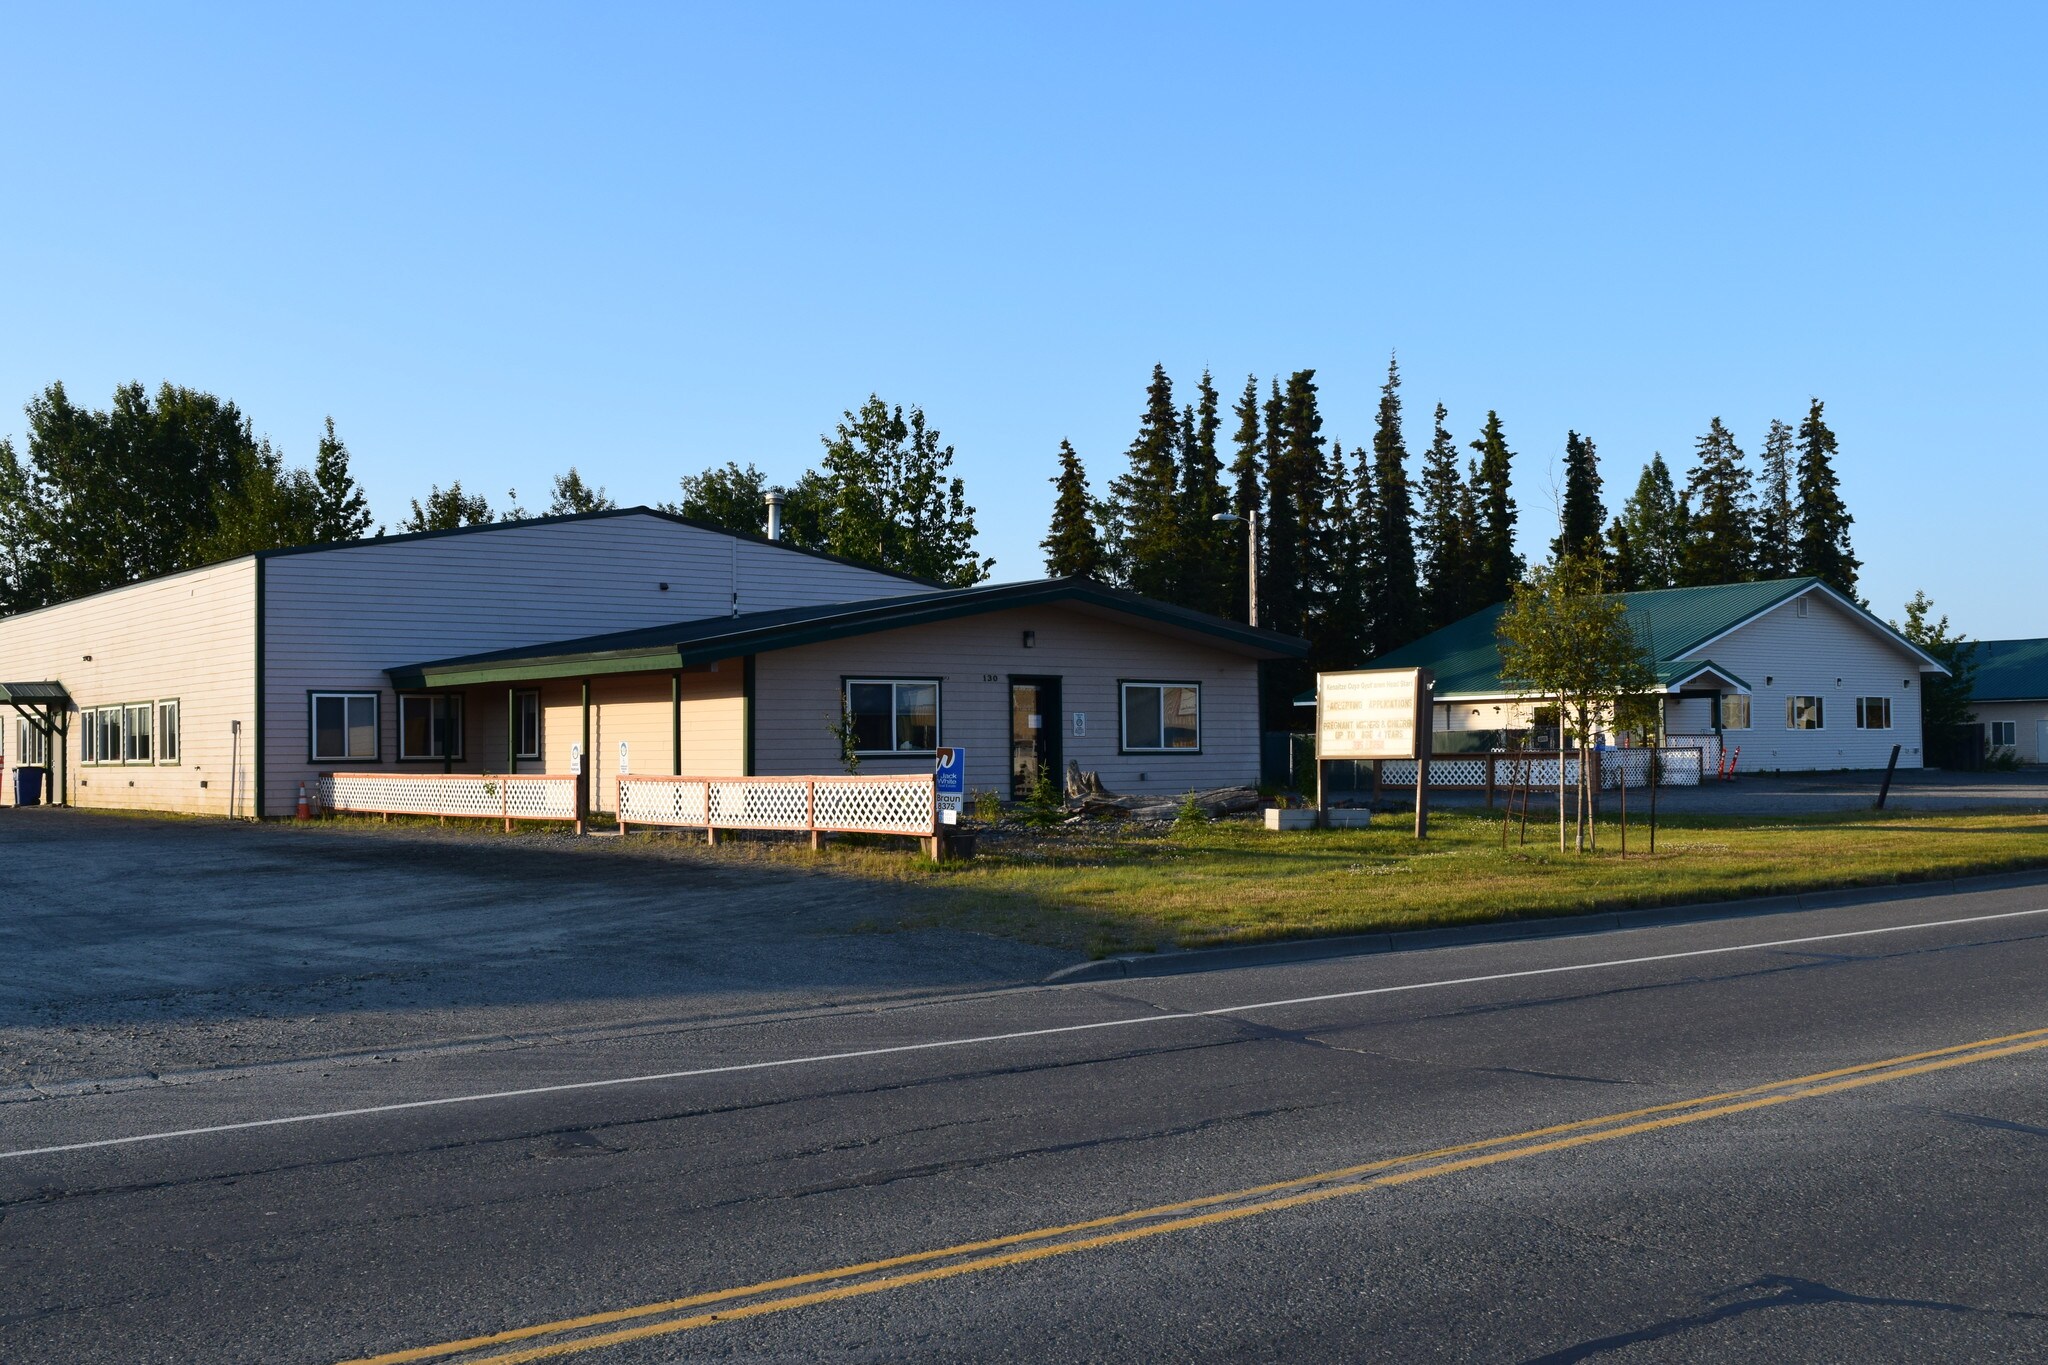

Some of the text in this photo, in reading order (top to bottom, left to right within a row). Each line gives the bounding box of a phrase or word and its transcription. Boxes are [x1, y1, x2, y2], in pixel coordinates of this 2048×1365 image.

[983, 674, 998, 682] 130
[1368, 699, 1412, 709] APPLICATIONS
[1324, 721, 1354, 731] PREGNANT
[1335, 732, 1344, 740] UP
[1347, 731, 1355, 739] TO
[1384, 730, 1404, 738] YEARS
[937, 794, 960, 802] Braun
